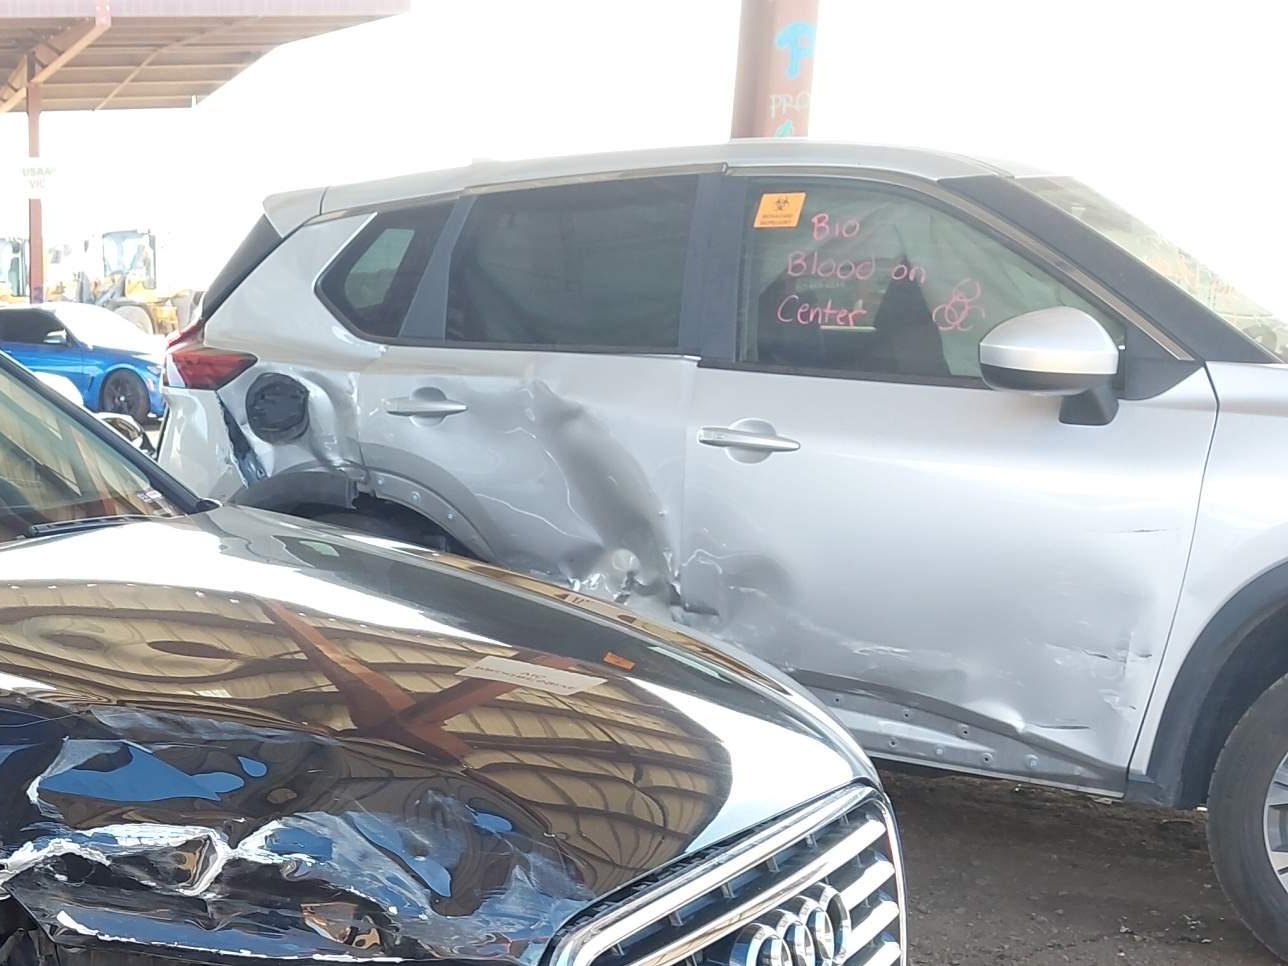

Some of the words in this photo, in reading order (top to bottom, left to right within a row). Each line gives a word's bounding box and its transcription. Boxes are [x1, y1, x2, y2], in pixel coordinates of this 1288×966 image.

[787, 250, 875, 280] Blood
[891, 263, 926, 284] on
[777, 293, 867, 328] Center
